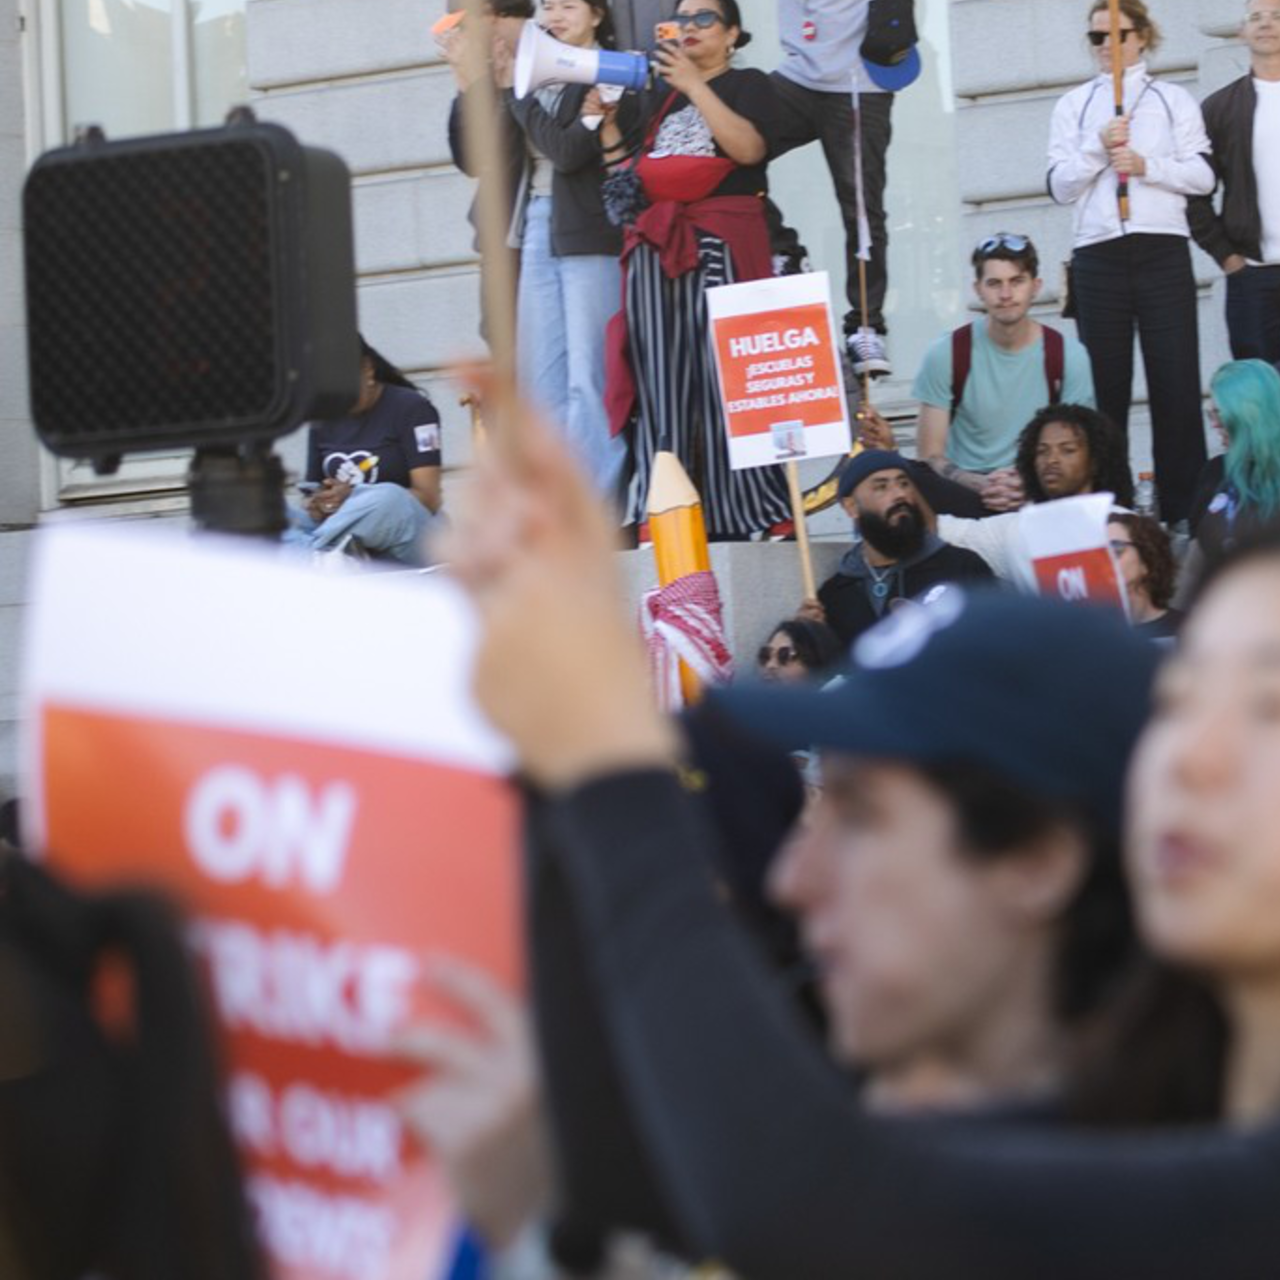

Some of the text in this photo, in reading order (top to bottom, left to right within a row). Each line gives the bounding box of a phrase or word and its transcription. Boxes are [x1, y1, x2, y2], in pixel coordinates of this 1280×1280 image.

[729, 327, 820, 358] HUELGA
[745, 375, 803, 394] SEGURAS
[1058, 567, 1088, 601] ON
[184, 764, 357, 893] ON
